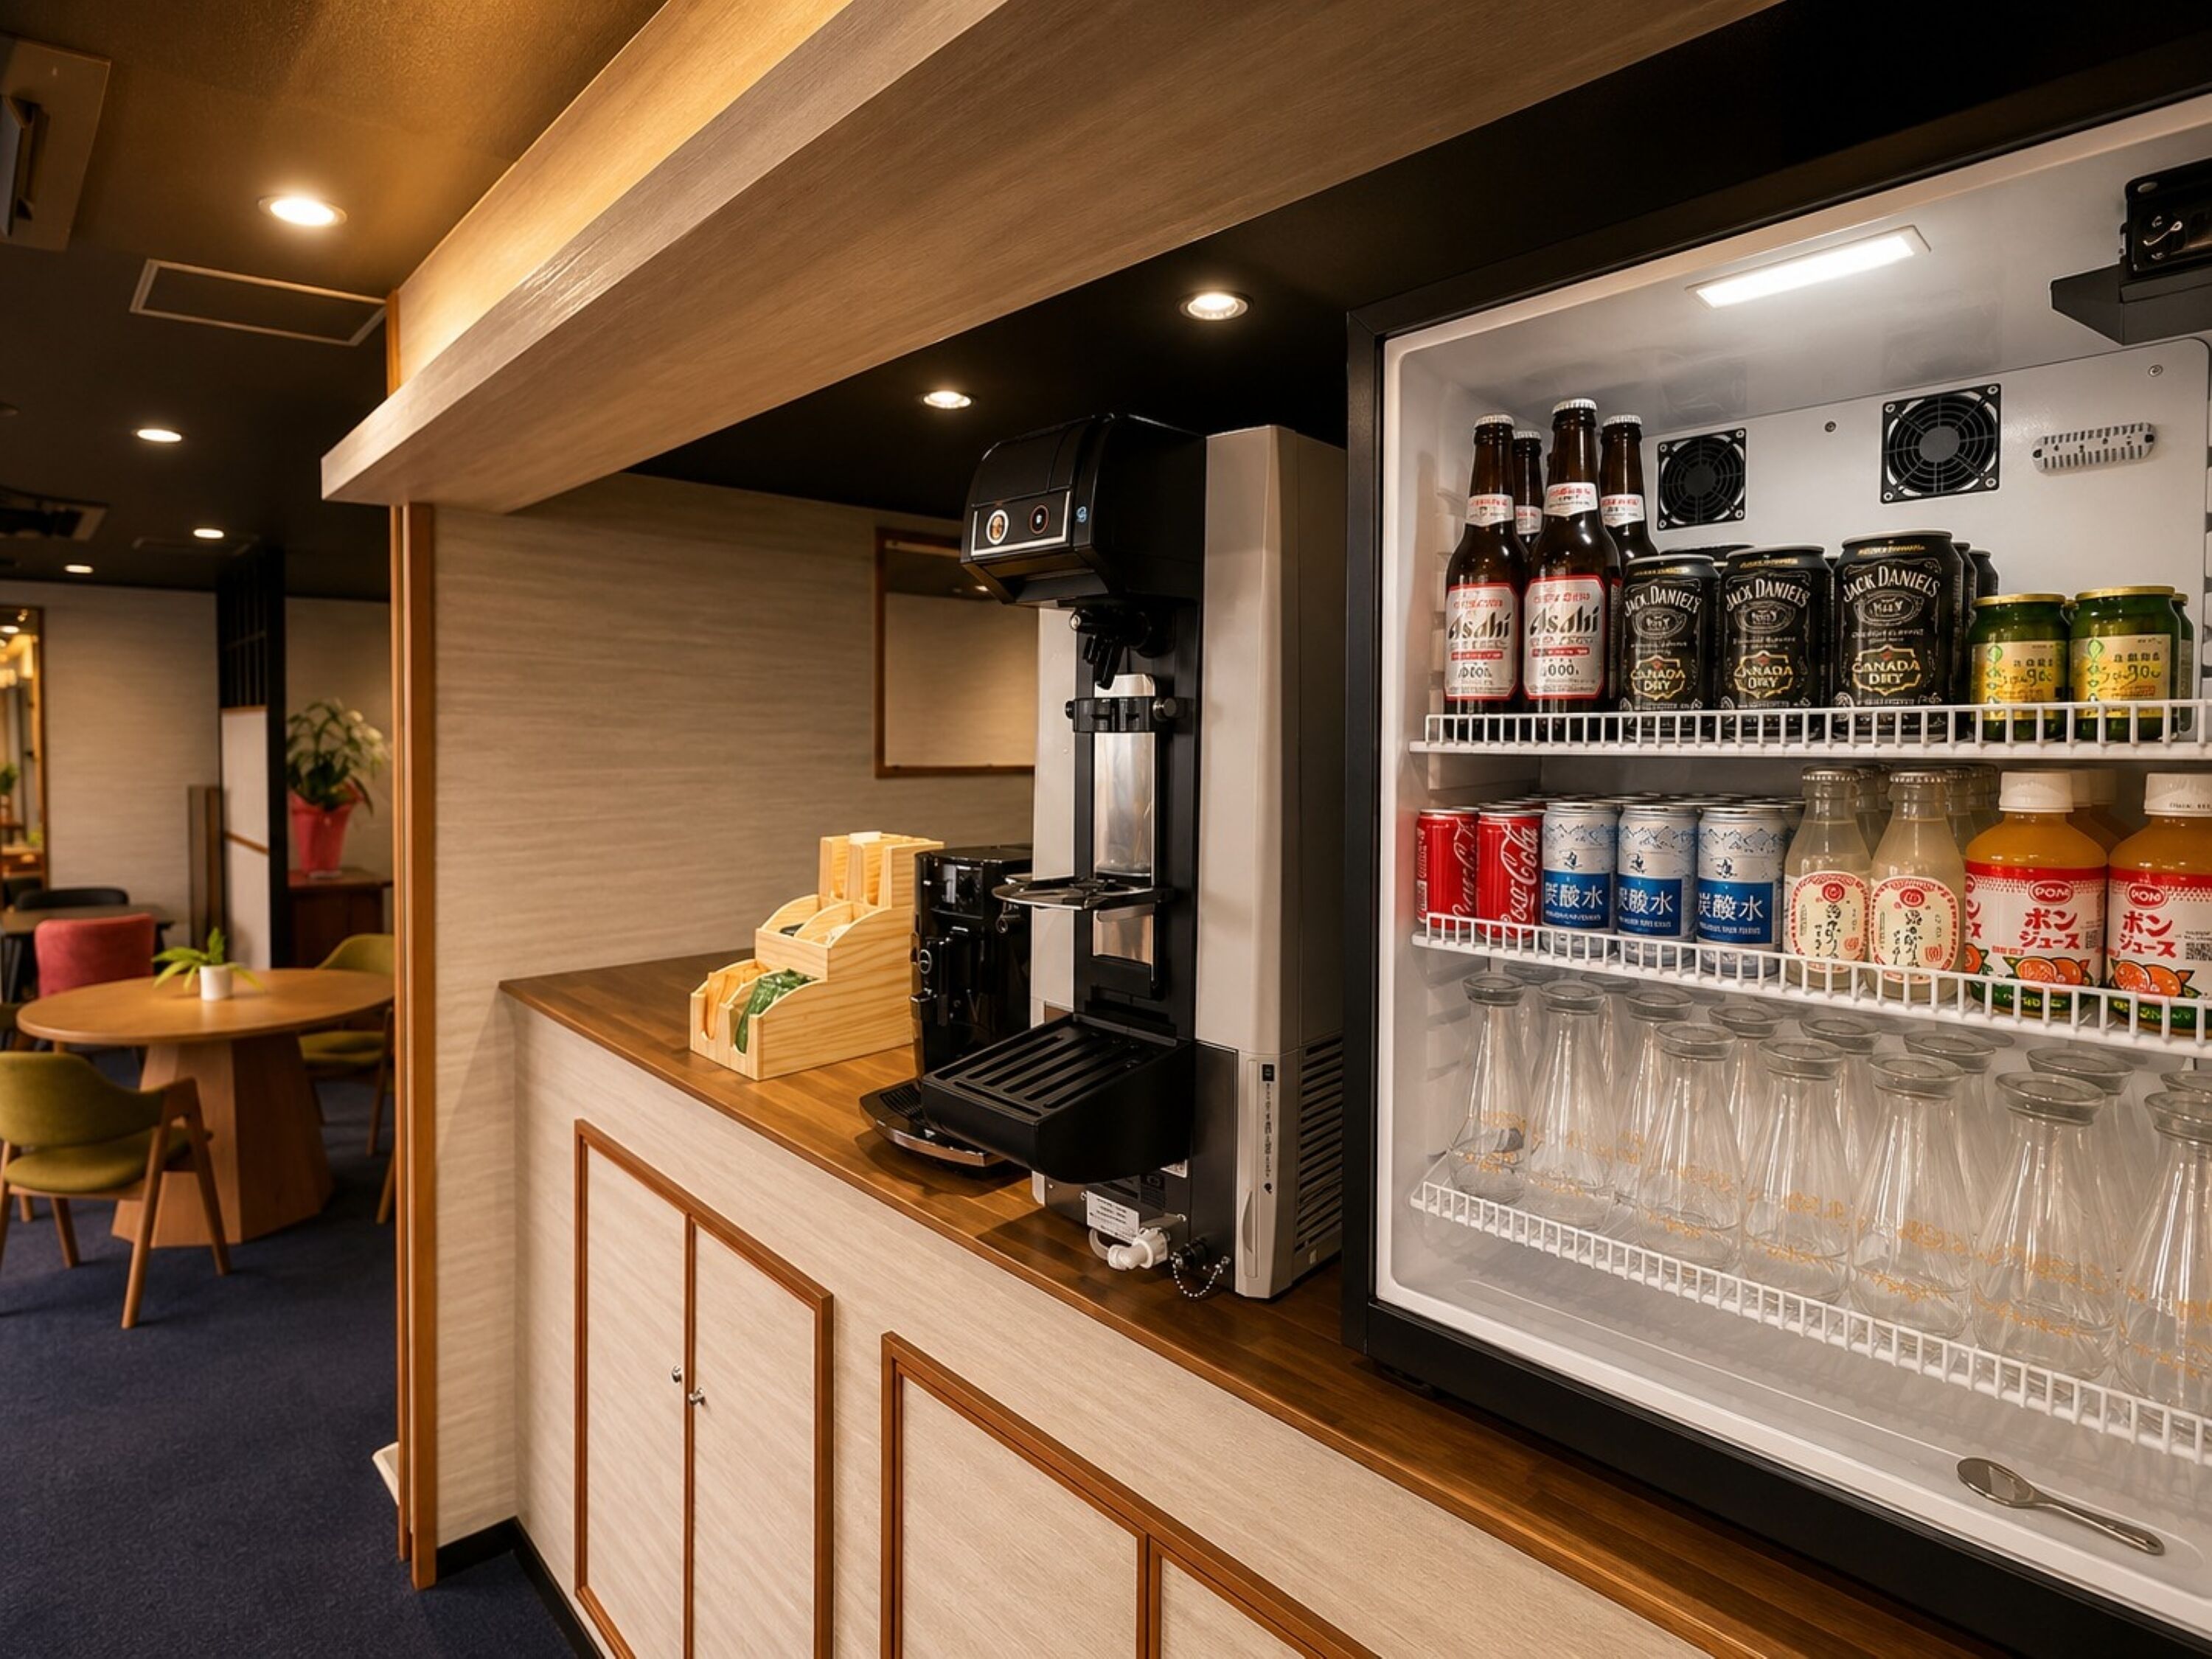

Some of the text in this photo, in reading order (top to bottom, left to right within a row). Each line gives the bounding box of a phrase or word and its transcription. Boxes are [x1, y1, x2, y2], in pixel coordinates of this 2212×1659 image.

[1843, 573, 1877, 602] JACK
[1447, 611, 1512, 640] Asahi
[1529, 605, 1600, 636] Asahi
[1851, 660, 1921, 674] CANADA
[2019, 931, 2081, 950] ジュース
[2119, 933, 2177, 959] ジュース
